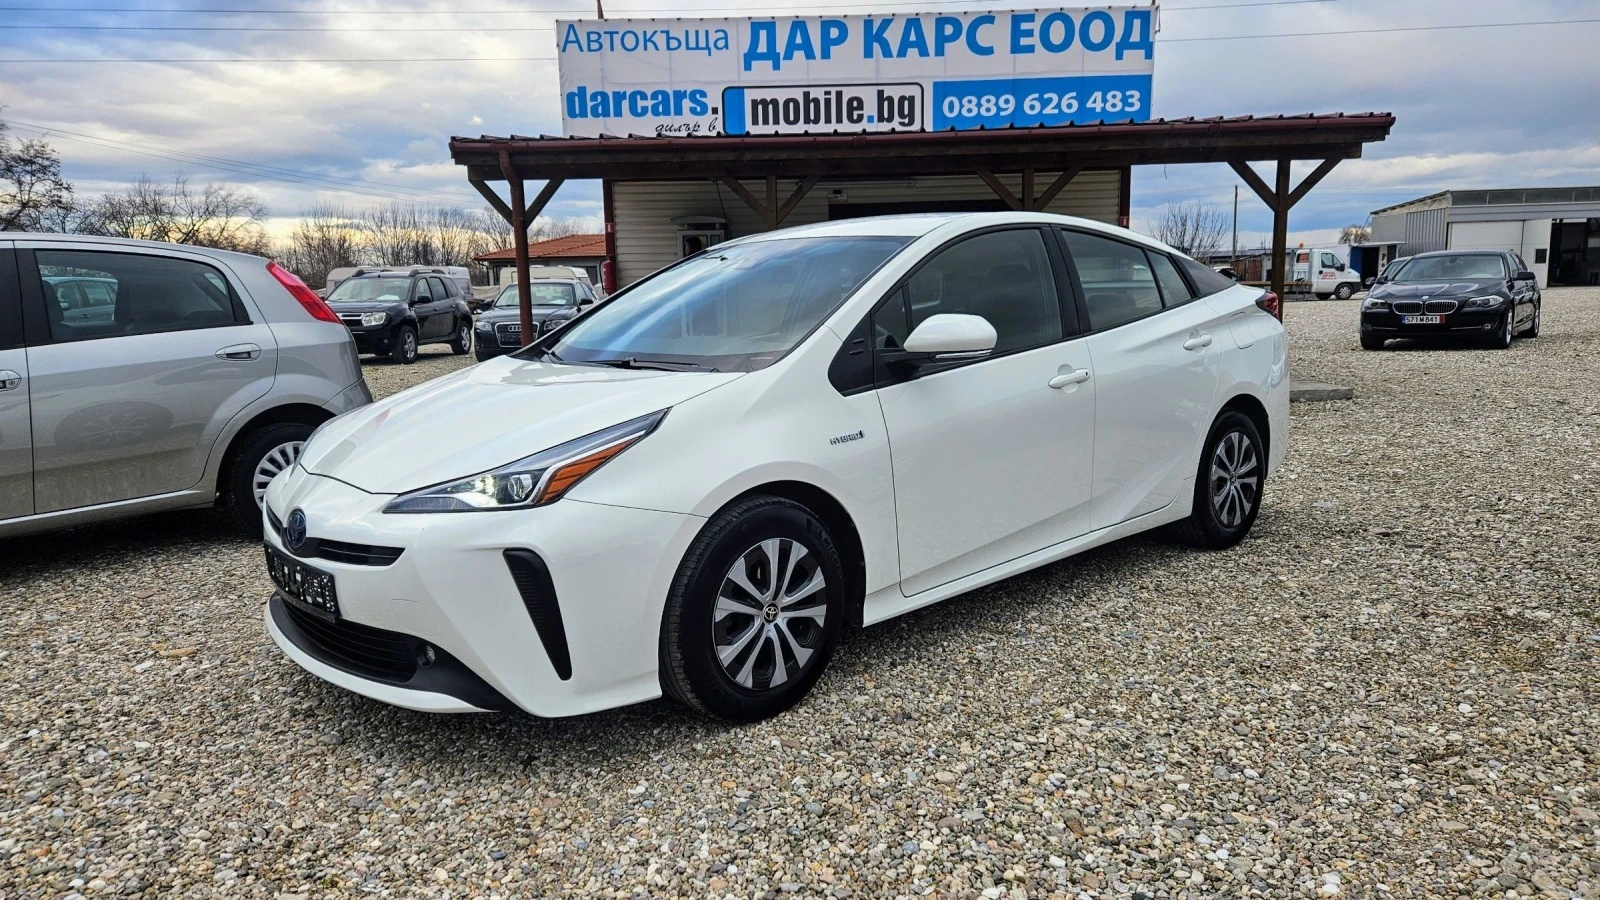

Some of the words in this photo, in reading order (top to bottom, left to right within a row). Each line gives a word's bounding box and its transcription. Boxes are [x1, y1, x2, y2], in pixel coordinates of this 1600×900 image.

[562, 24, 729, 56] Автокъща
[743, 20, 849, 71] ДАР
[863, 15, 996, 59] КАРС
[1010, 10, 1154, 61] ЕООД
[751, 89, 915, 127] mobile.bg
[942, 94, 1016, 118] 0889
[1023, 92, 1078, 115] 626
[1085, 90, 1141, 113] 483
[655, 121, 701, 133] дилър
